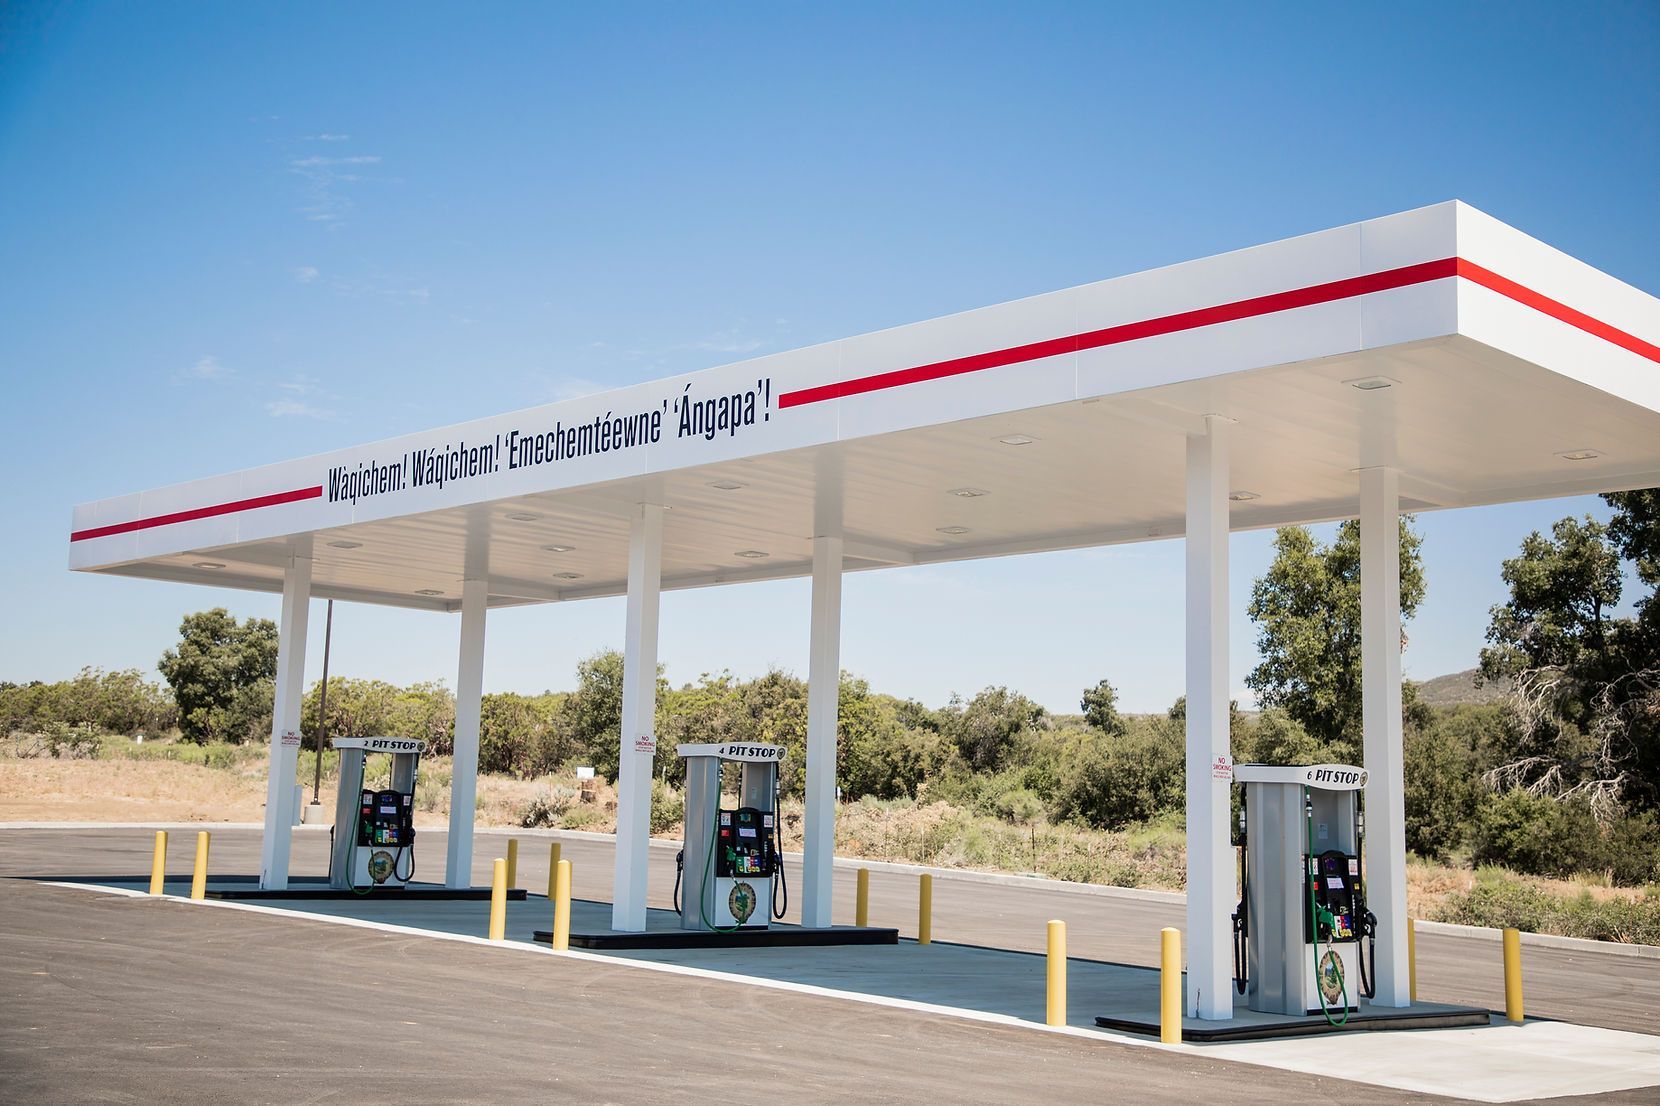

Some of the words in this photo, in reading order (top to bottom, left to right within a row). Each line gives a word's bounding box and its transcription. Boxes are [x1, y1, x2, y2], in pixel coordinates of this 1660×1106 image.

[412, 435, 500, 490] Wáqichem!
[372, 740, 390, 748] PIT
[390, 740, 416, 750] STOP
[729, 746, 748, 756] PIT
[748, 747, 775, 758] STOP
[1213, 763, 1231, 771] SMOKING
[1307, 770, 1312, 779] 6
[1315, 769, 1333, 781] PIT
[1333, 770, 1359, 784] STOP
